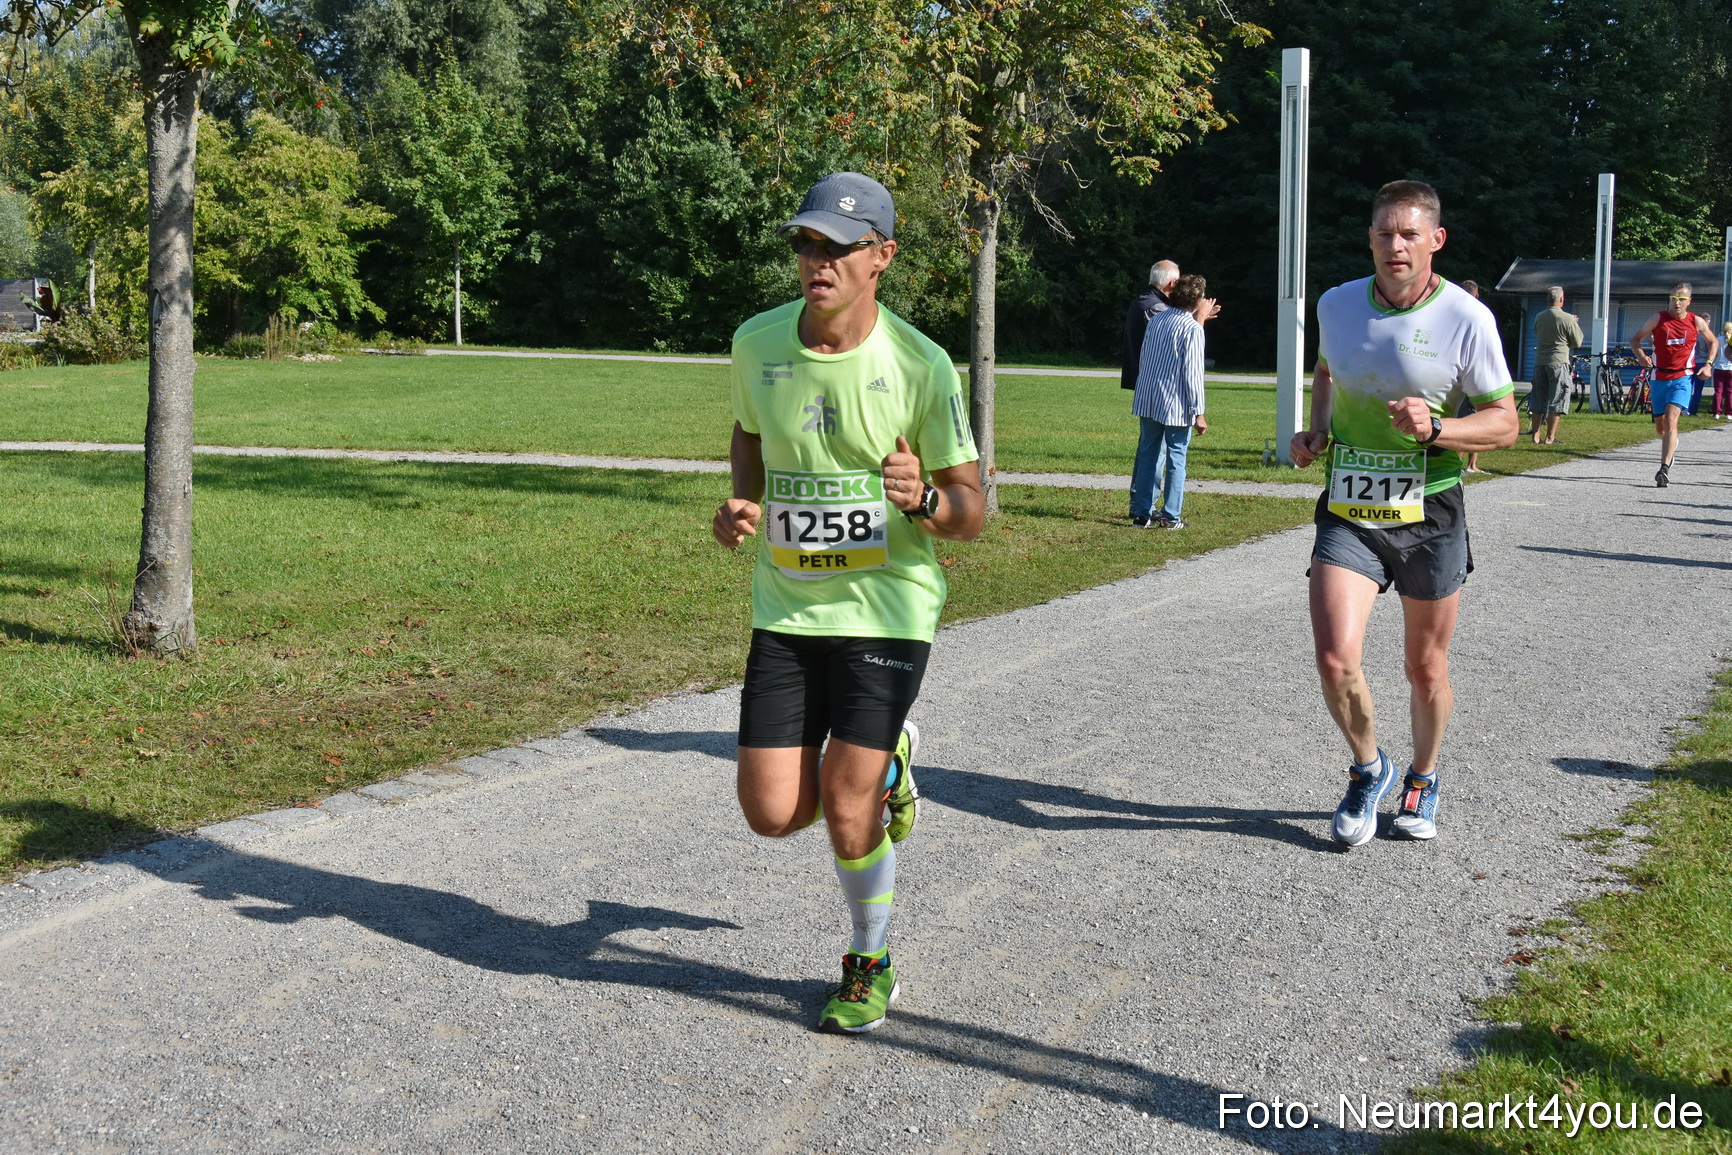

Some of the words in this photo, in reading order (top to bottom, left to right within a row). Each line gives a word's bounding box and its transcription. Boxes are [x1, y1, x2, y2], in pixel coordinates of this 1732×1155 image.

[1398, 343, 1411, 353] Dr.
[1413, 347, 1439, 358] Loew
[866, 385, 890, 394] adidas
[1342, 450, 1415, 469] BOCK
[774, 477, 868, 499] BOCK
[1342, 475, 1413, 501] 1217
[874, 510, 881, 518] C
[1348, 508, 1402, 520] OLIVER
[777, 510, 872, 543] 1258
[798, 554, 848, 568] PETR
